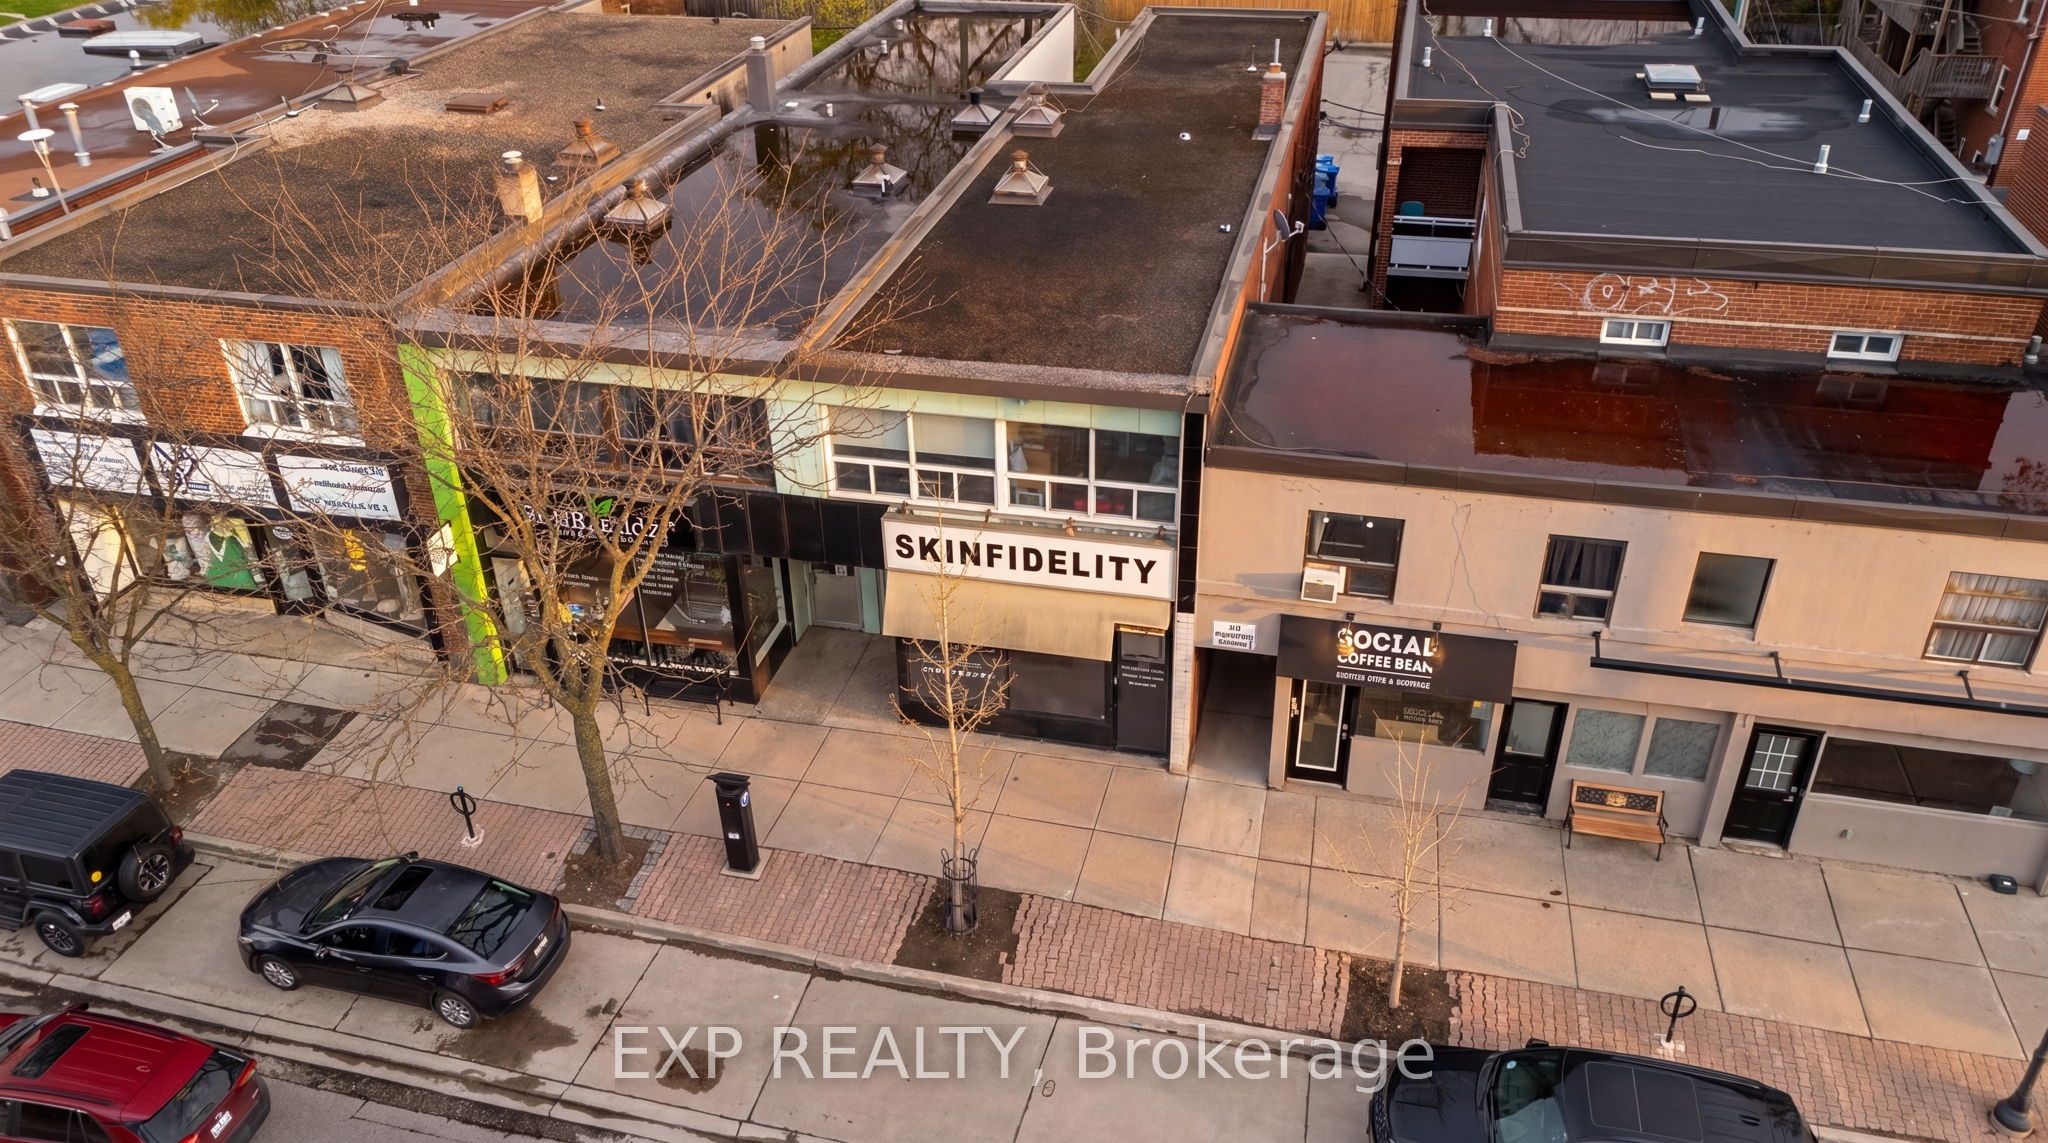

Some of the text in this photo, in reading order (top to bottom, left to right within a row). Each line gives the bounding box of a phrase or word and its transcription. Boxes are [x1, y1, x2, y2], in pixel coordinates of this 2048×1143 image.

[895, 533, 1157, 584] SKINFIDELITY
[1337, 627, 1434, 657] SOCIAL
[1394, 657, 1433, 674] BEAN
